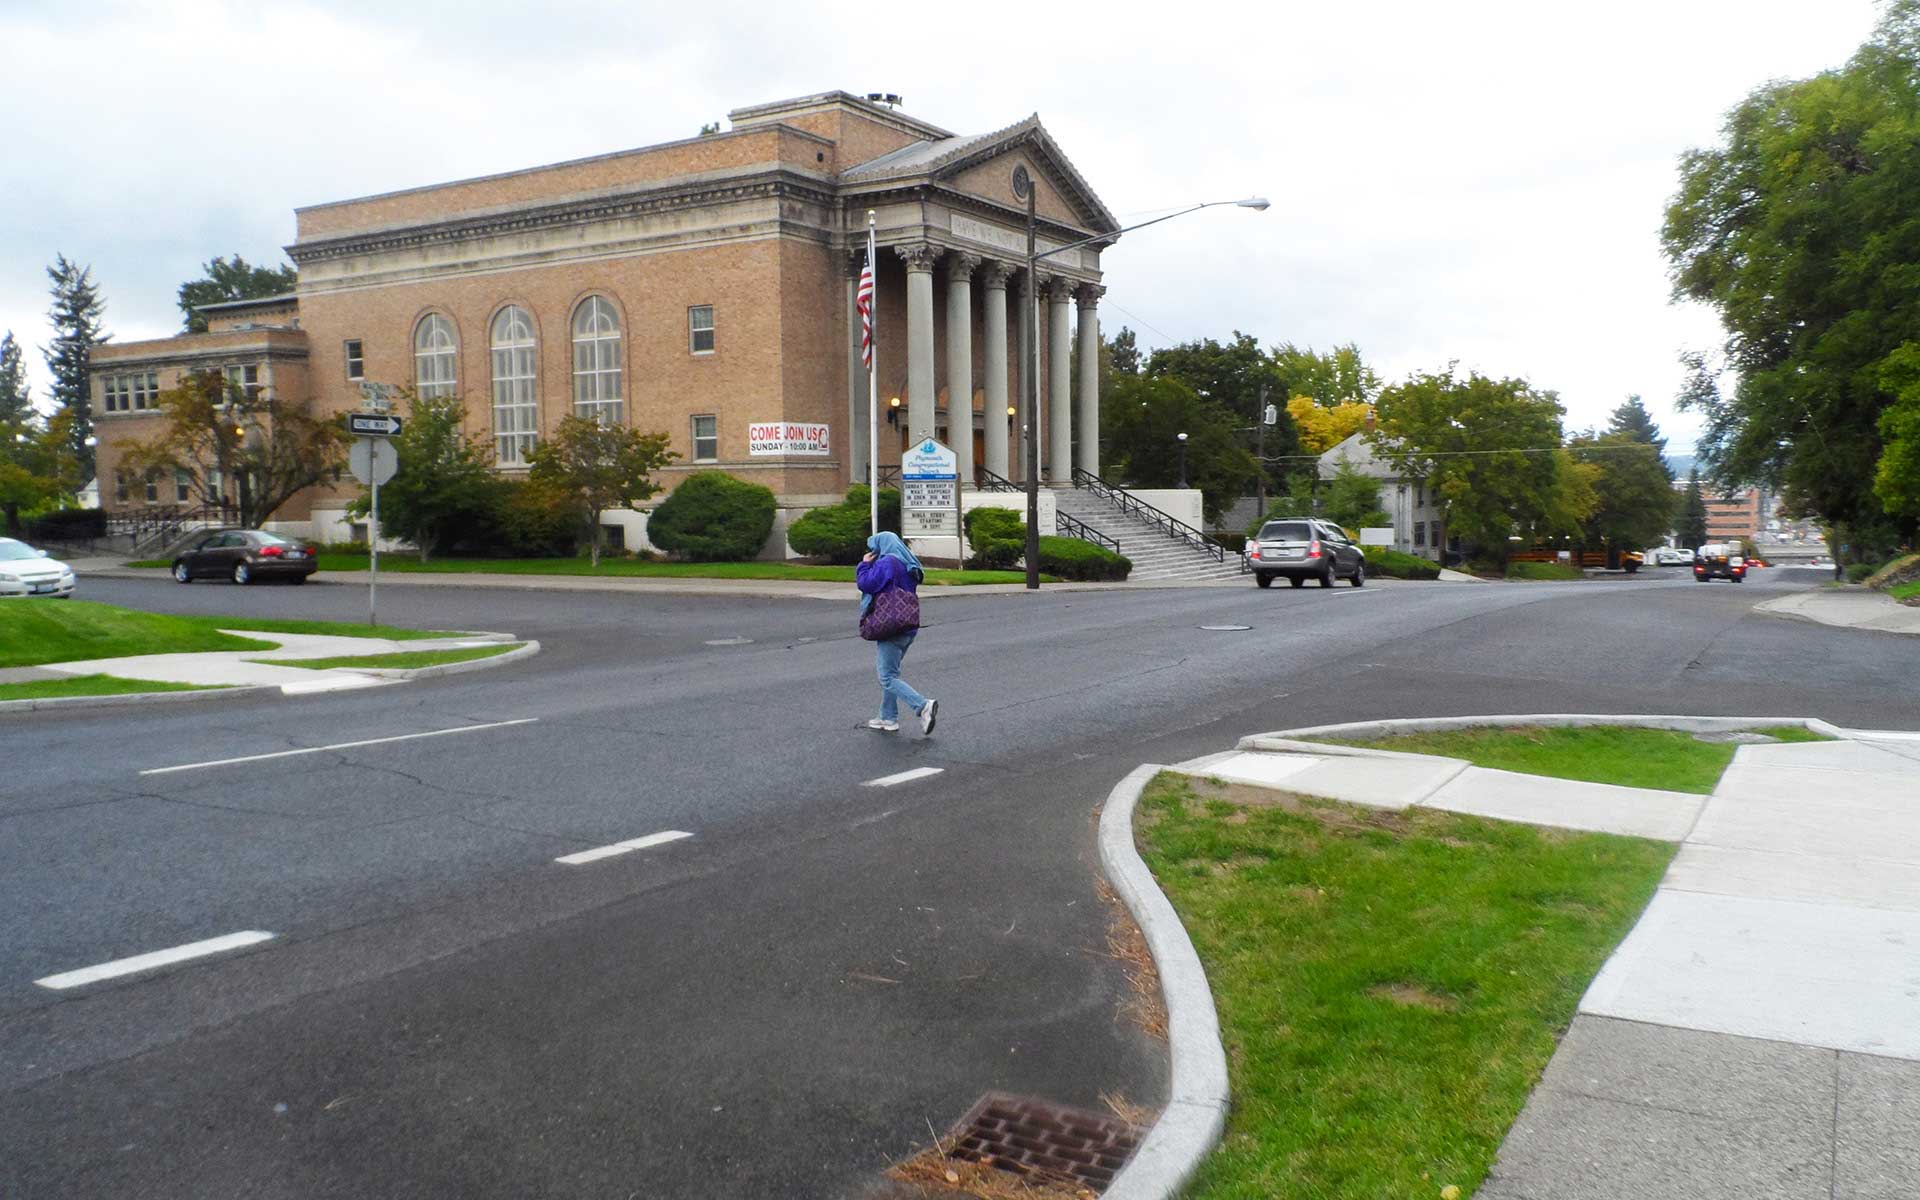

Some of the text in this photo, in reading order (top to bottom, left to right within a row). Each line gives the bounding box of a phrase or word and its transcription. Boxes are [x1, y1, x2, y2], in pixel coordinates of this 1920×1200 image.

[356, 420, 387, 429] ONE WAY
[751, 426, 818, 441] COME JOIN US
[751, 443, 784, 451] SUNDAY
[808, 443, 818, 451] AM
